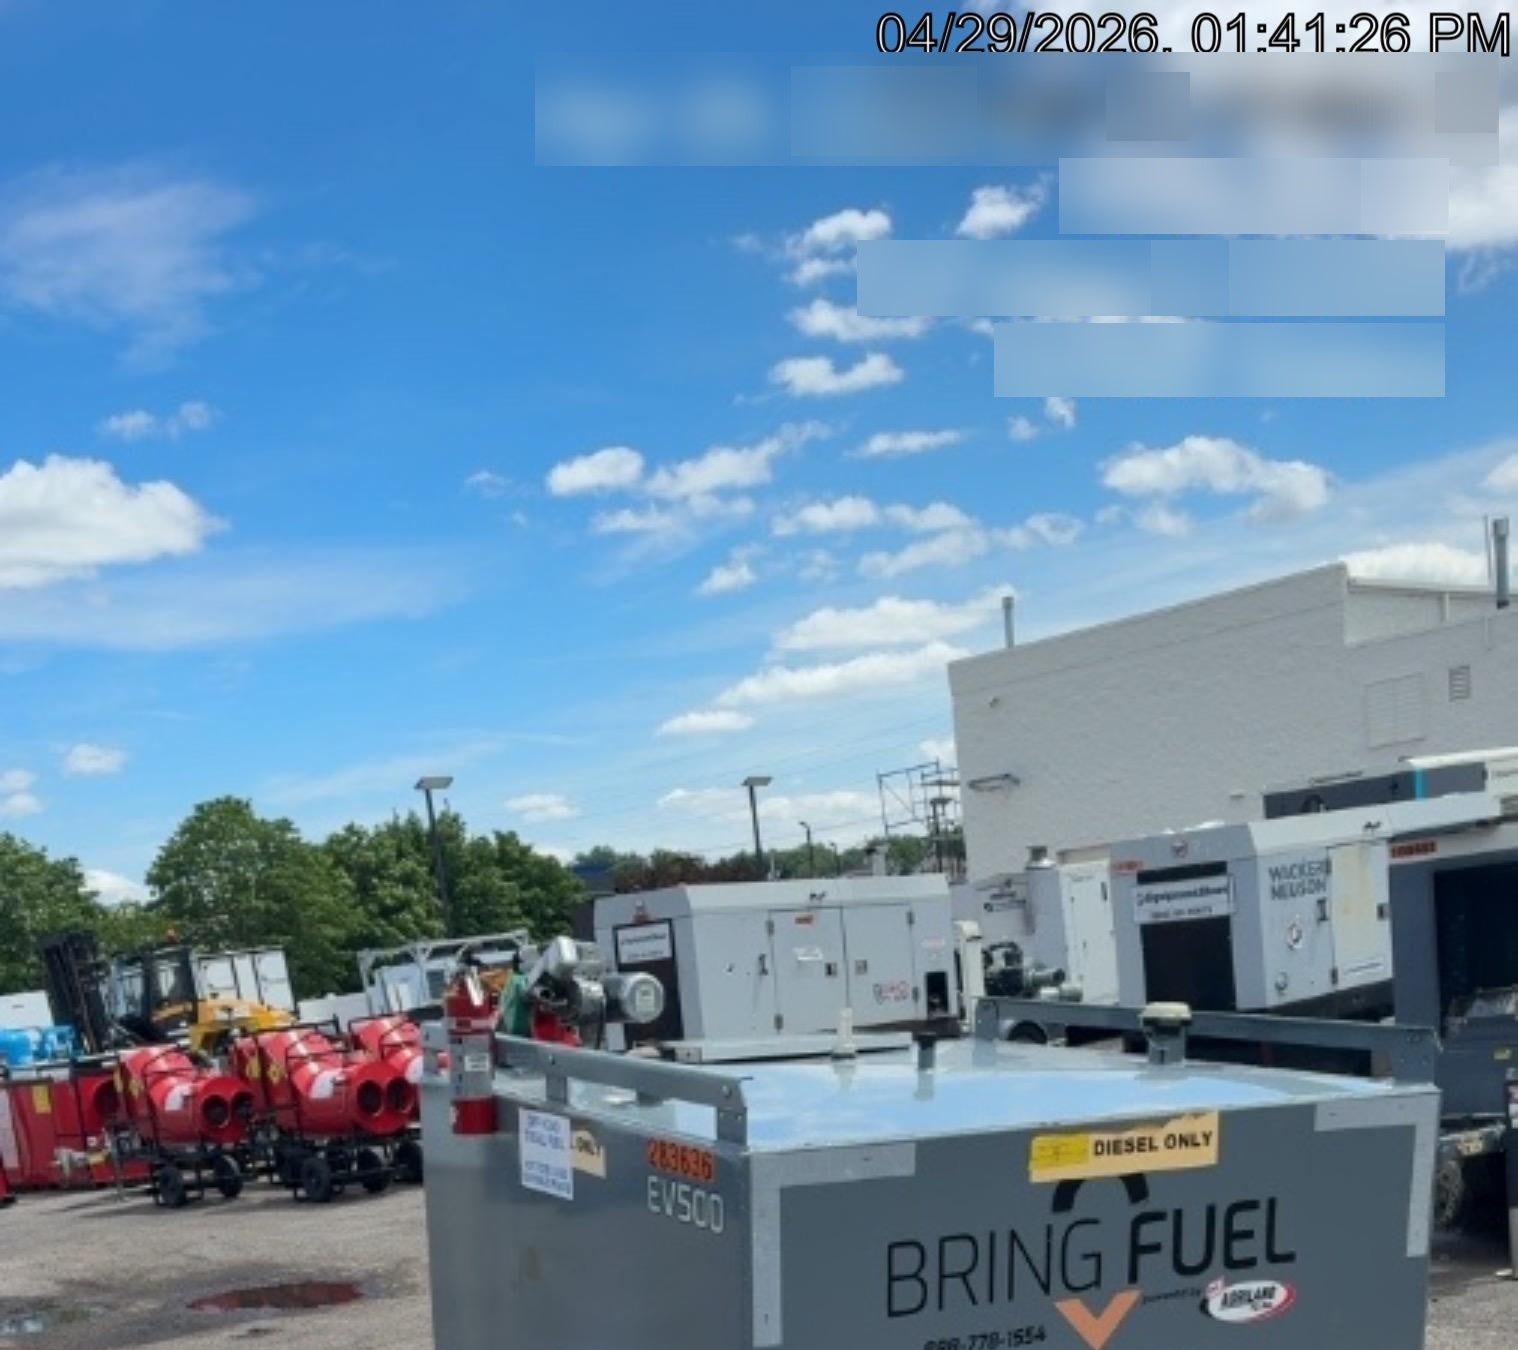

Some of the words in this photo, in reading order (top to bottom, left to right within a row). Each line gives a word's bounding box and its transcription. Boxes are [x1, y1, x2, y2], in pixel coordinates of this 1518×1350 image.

[1094, 1138, 1158, 1156] DIESEL
[1164, 1131, 1212, 1150] ONLY
[647, 1175, 724, 1233] EV500
[887, 1219, 1100, 1318] BRING
[1127, 1197, 1296, 1285] FUEL
